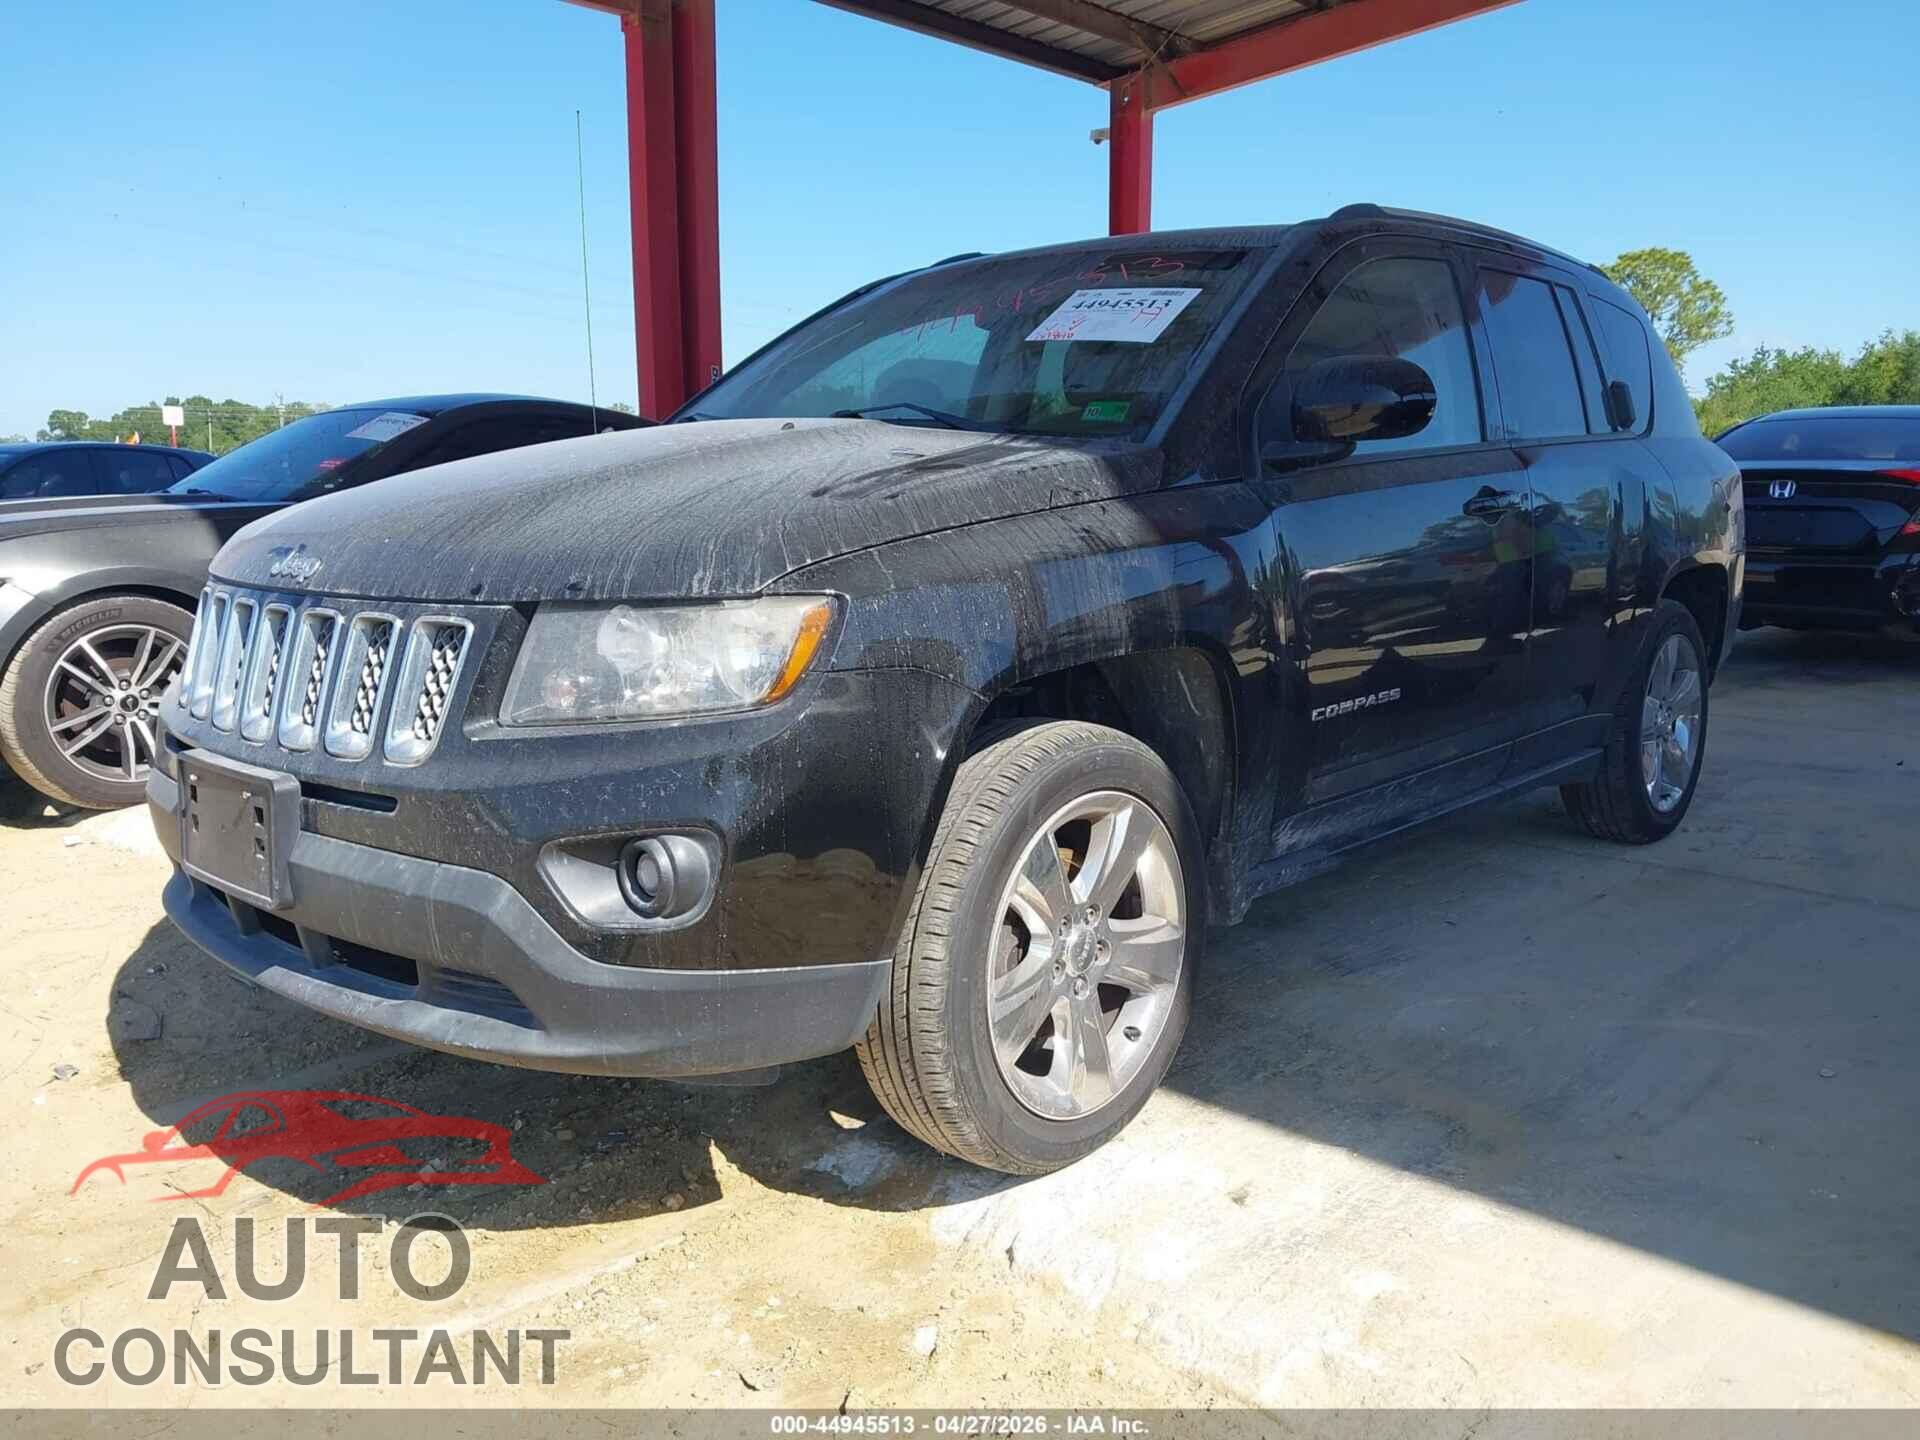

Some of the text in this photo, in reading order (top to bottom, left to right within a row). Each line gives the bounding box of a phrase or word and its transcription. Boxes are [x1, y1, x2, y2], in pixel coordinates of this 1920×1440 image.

[1071, 299, 1171, 310] 44945513
[270, 549, 325, 583] Jeep
[59, 607, 122, 641] MICHELIN
[1311, 687, 1401, 721] COMPASS
